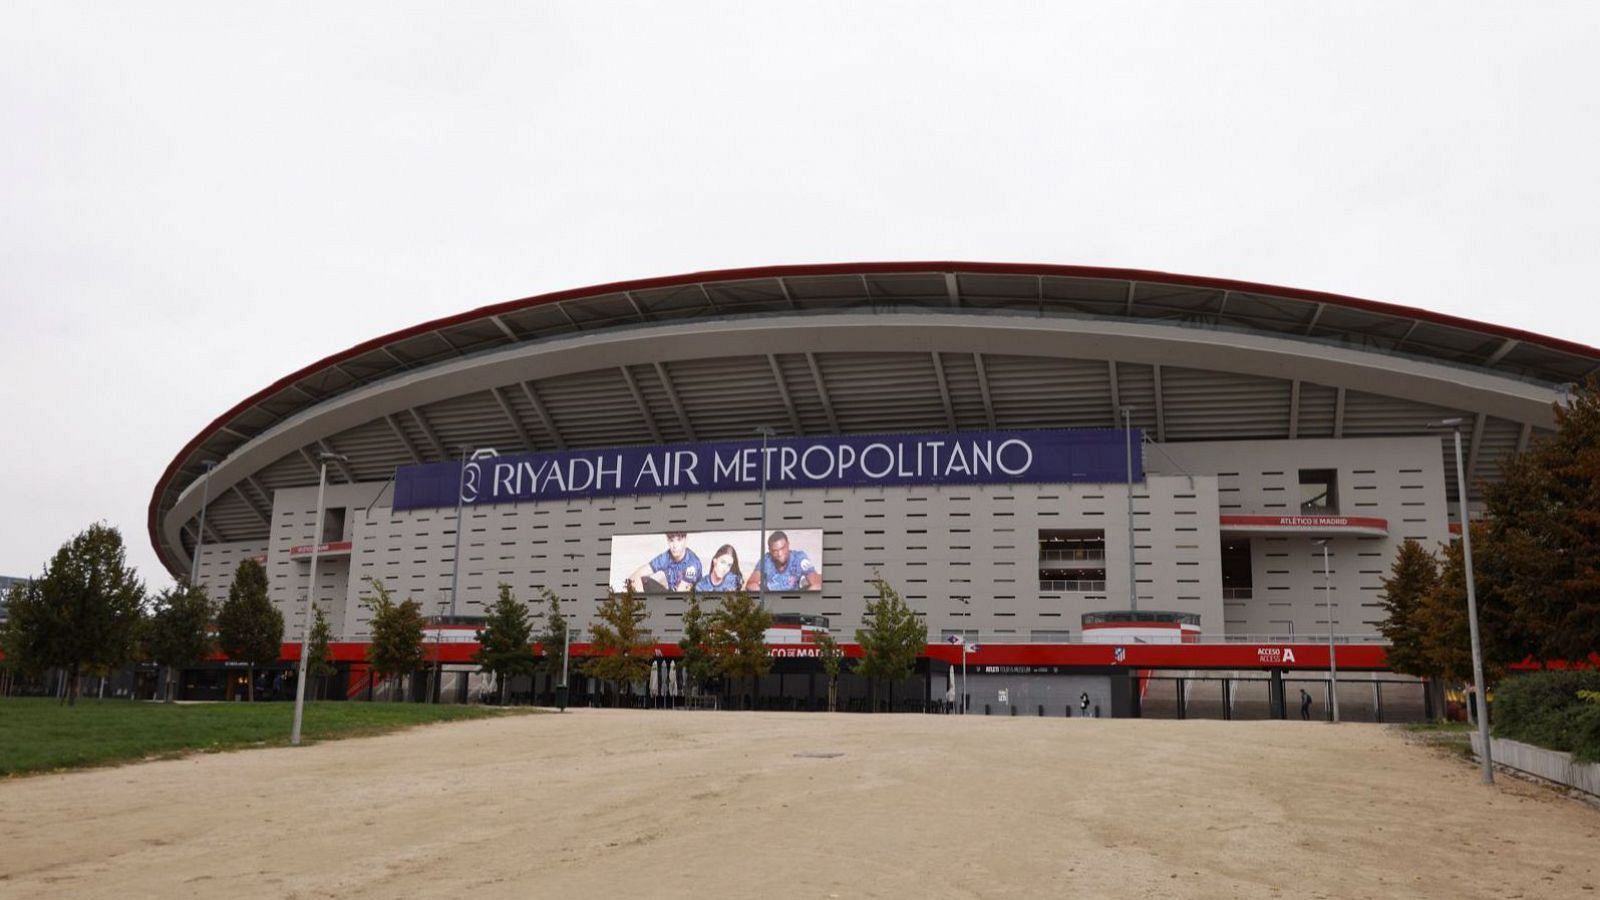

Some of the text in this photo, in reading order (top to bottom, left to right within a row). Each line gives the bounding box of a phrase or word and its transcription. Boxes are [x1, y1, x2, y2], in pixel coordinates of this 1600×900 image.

[493, 438, 1033, 497] RIYADH AIR METROPOLITANO
[1319, 518, 1348, 526] MADRID
[1259, 655, 1281, 663] ACCESS
[1282, 648, 1295, 663] A
